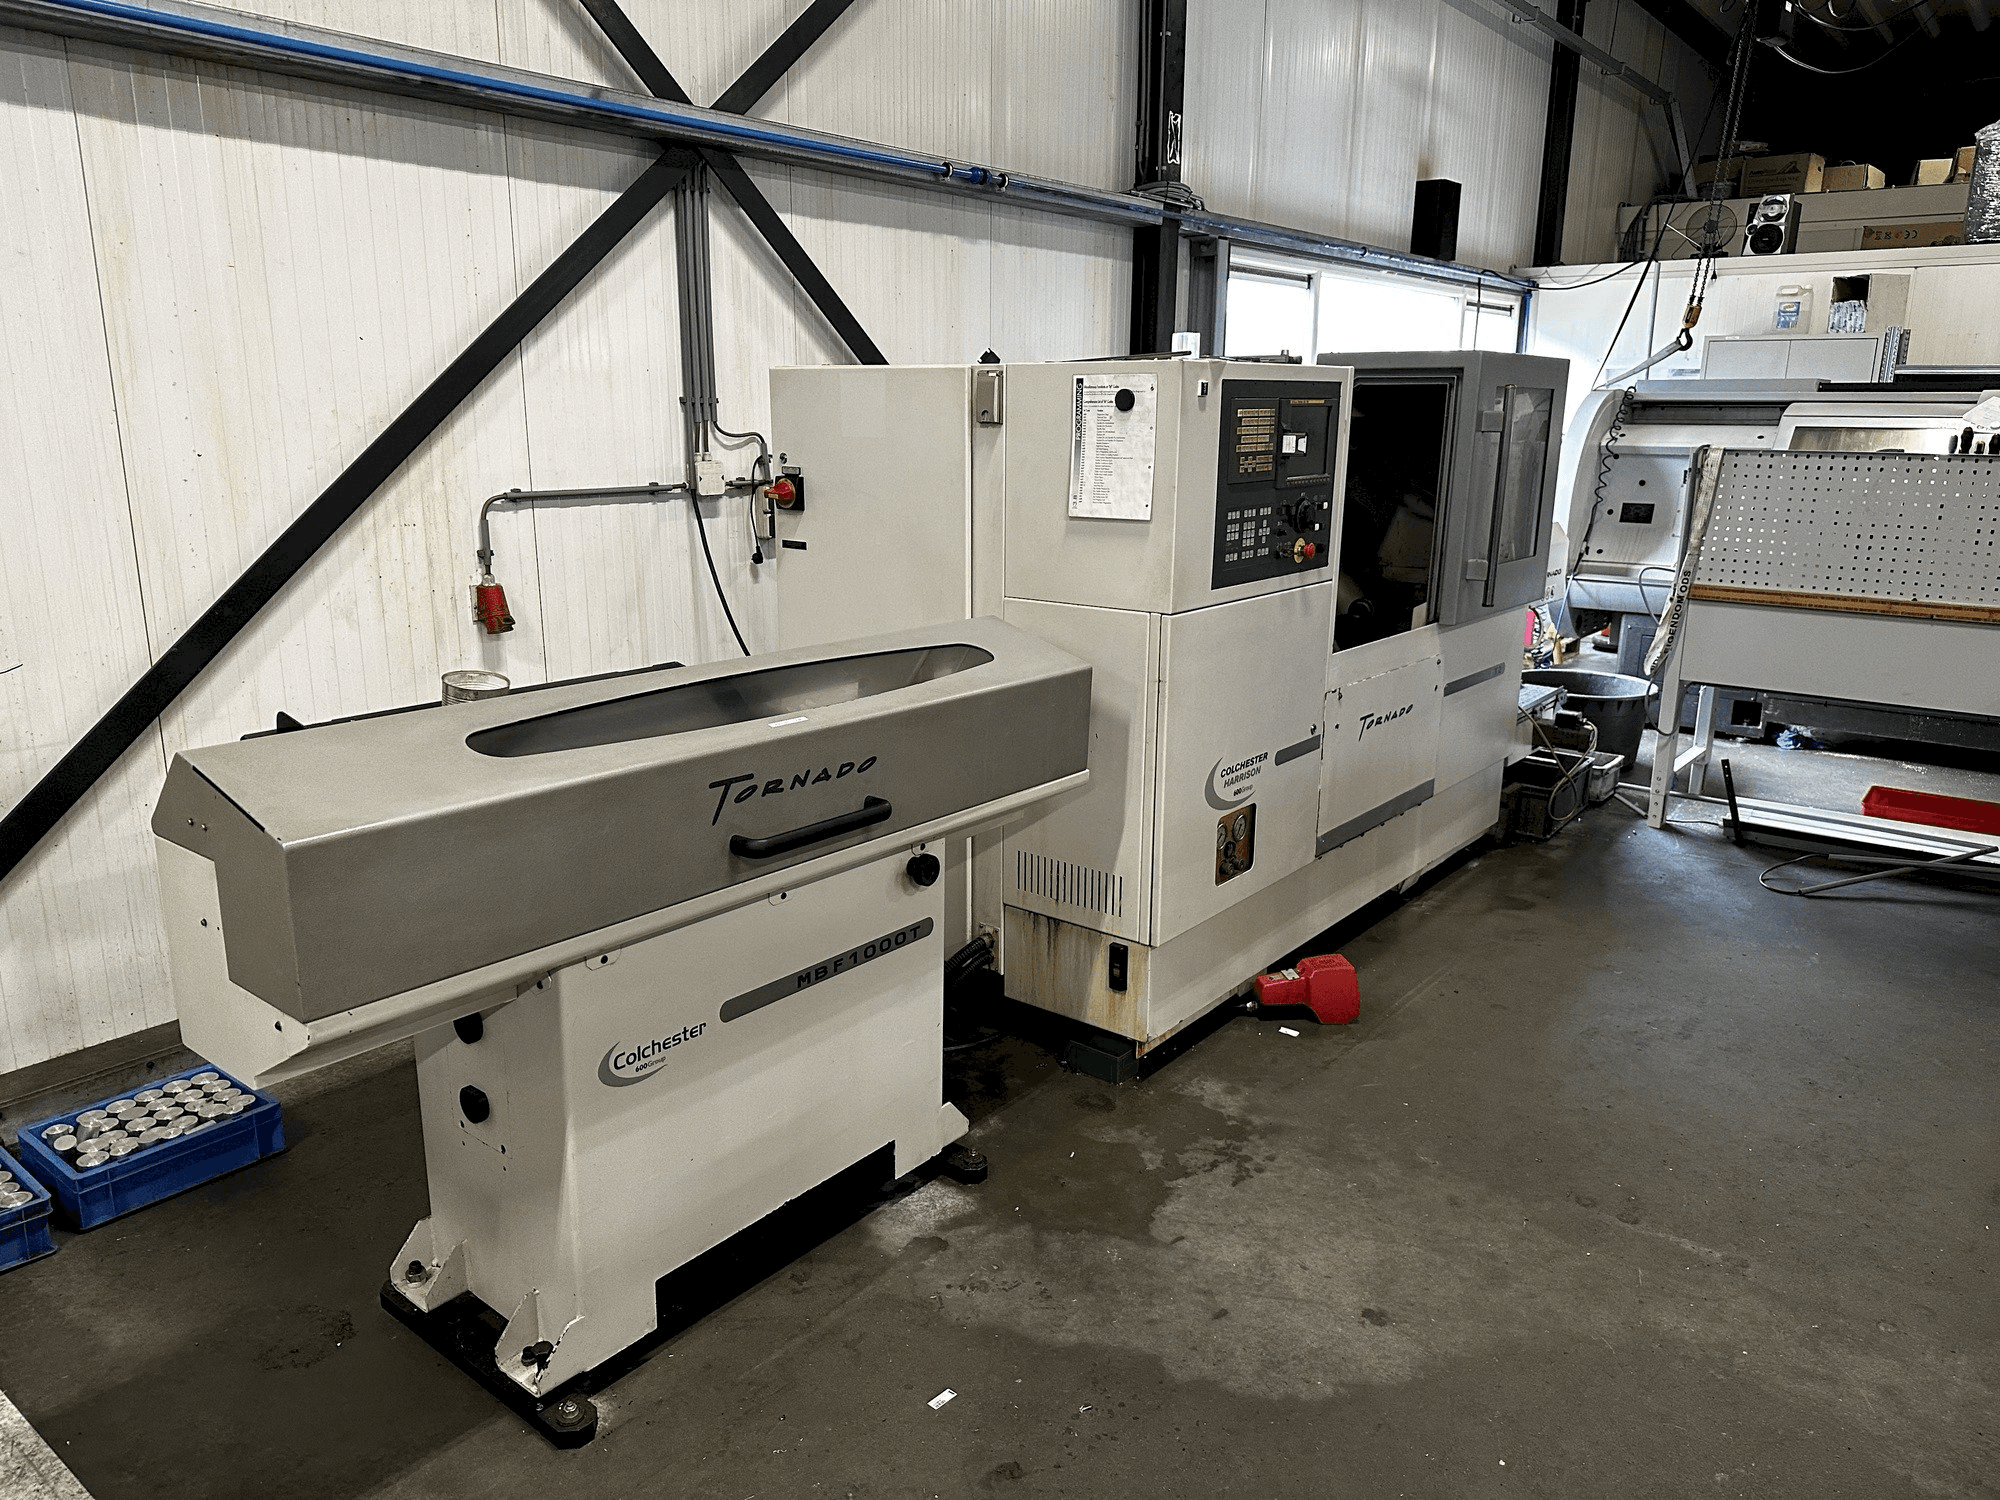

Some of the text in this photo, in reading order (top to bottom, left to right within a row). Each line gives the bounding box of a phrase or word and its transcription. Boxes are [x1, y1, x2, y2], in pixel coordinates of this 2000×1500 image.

[1075, 382, 1083, 440] PROGRAMMING
[1680, 570, 1691, 593] ODS
[1358, 703, 1414, 742] TORNADO
[1220, 751, 1269, 778] COLCHESTER
[1223, 766, 1262, 788] HARRISON
[709, 755, 878, 827] TORNADO
[797, 925, 922, 988] MBF1000T
[613, 1022, 707, 1070] Colchester
